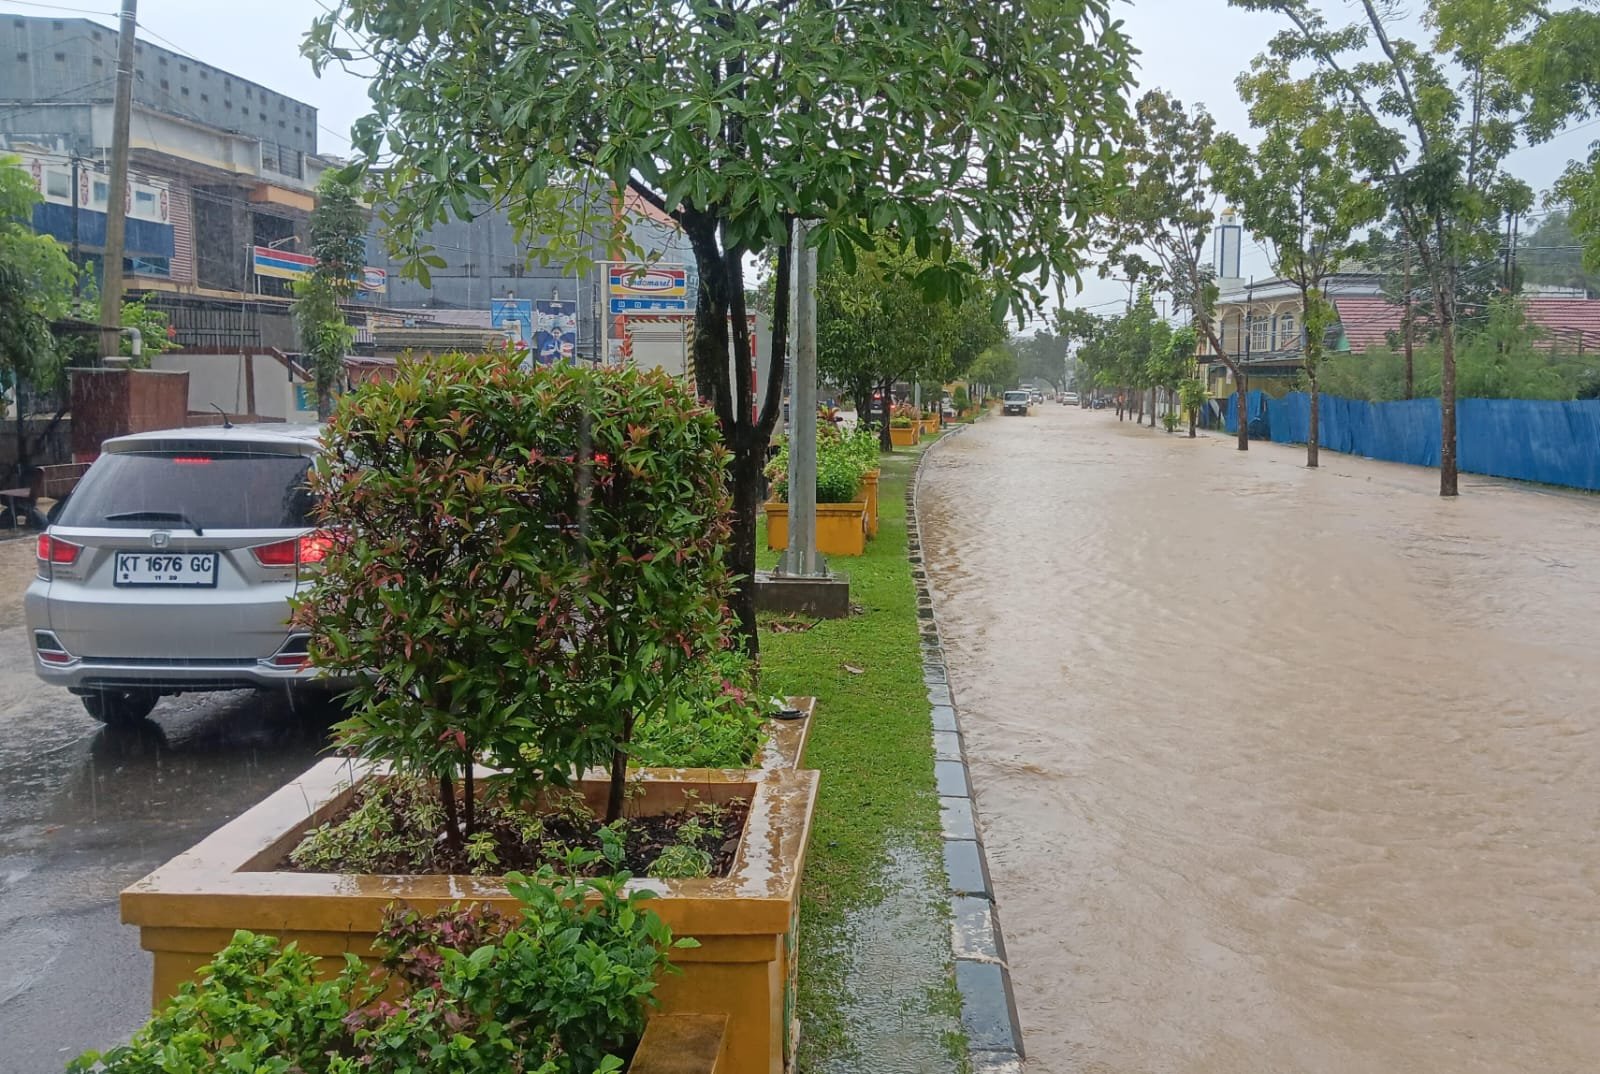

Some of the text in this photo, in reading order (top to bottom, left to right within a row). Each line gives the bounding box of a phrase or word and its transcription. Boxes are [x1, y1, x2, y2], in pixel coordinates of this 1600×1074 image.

[120, 556, 213, 573] KT 1676 GC
